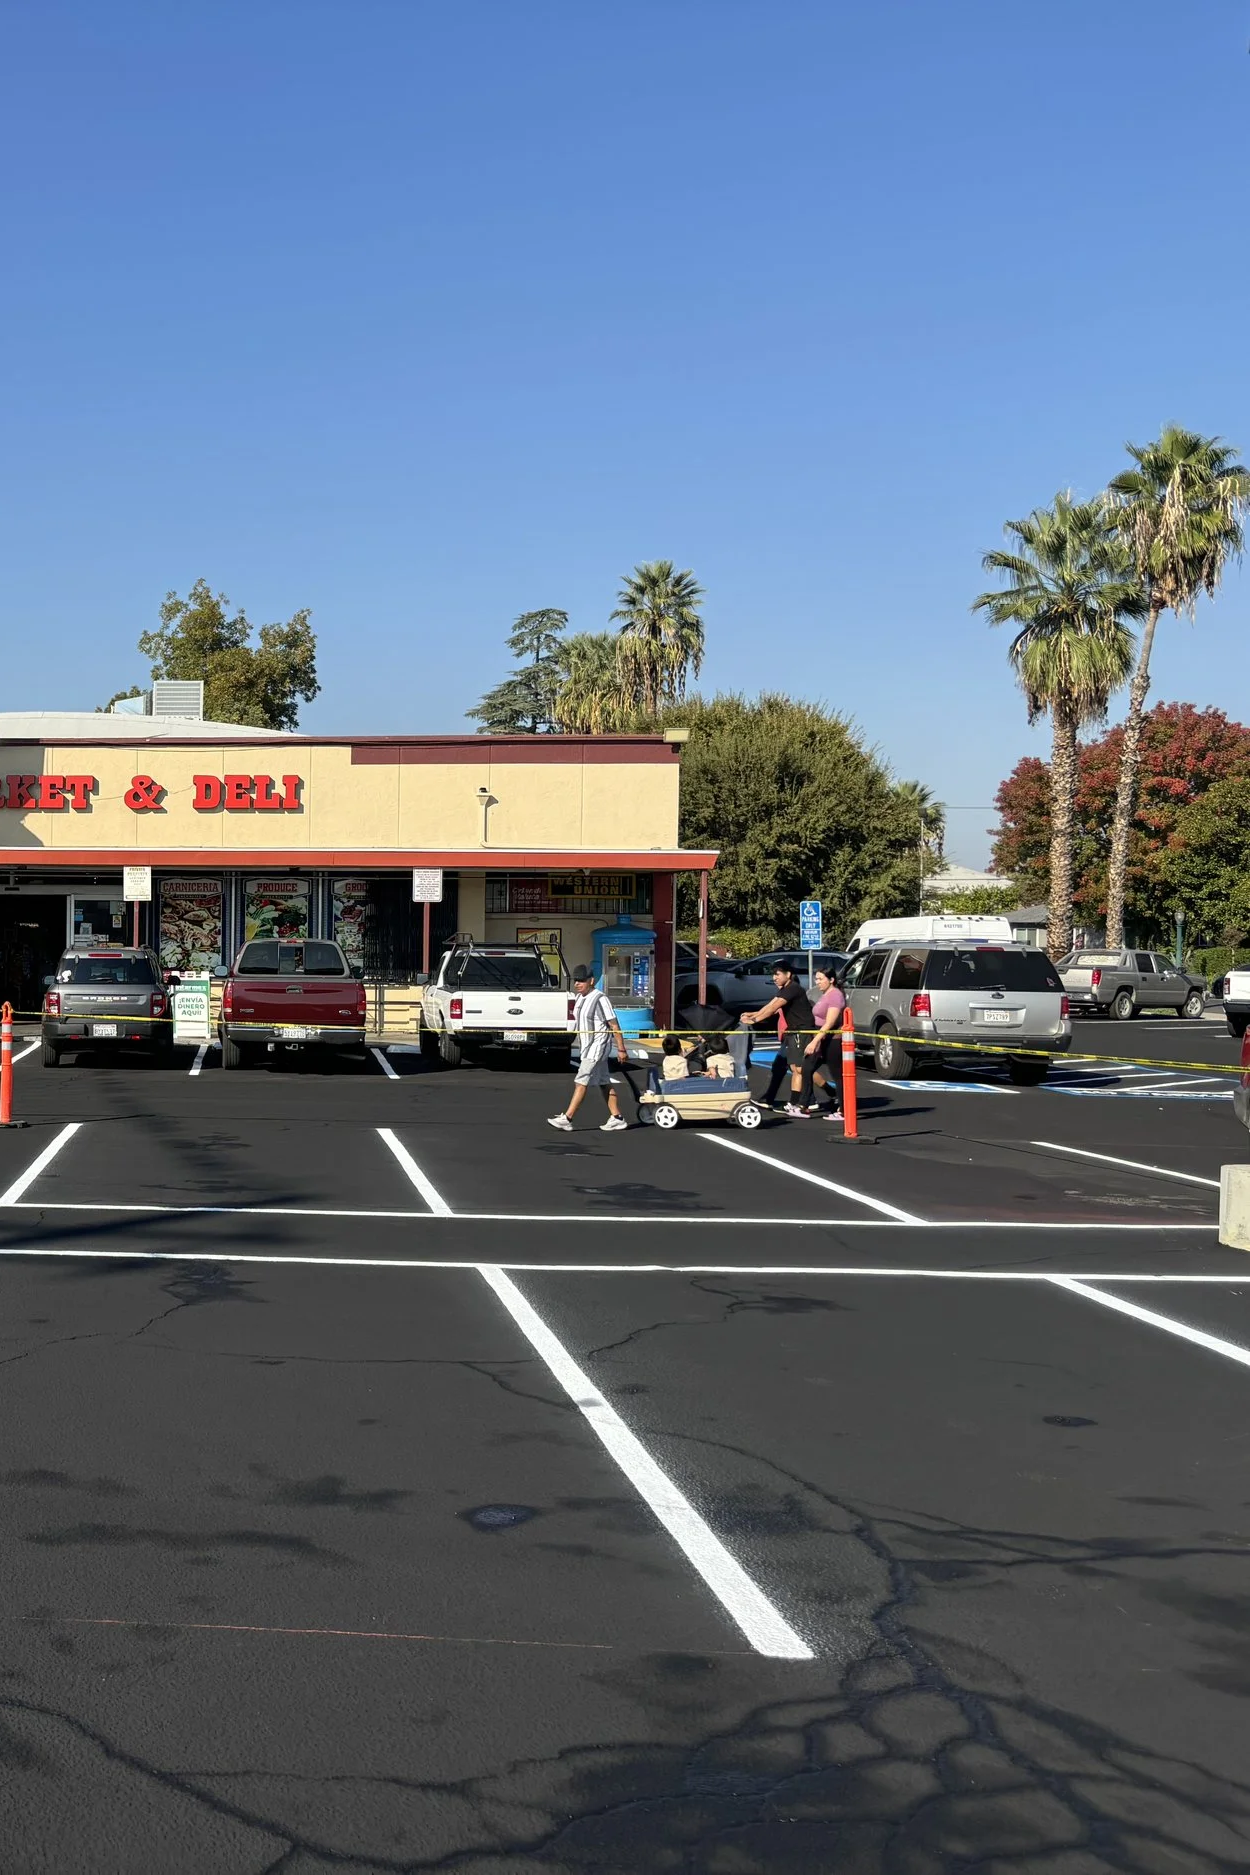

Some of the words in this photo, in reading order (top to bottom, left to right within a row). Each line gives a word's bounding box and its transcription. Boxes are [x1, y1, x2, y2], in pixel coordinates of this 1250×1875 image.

[124, 775, 162, 809] &
[193, 775, 299, 809] DELI
[553, 876, 620, 886] WESTERN
[163, 882, 219, 893] CARNICERIA
[257, 882, 298, 893] PRODUCE
[574, 885, 620, 895] UNION
